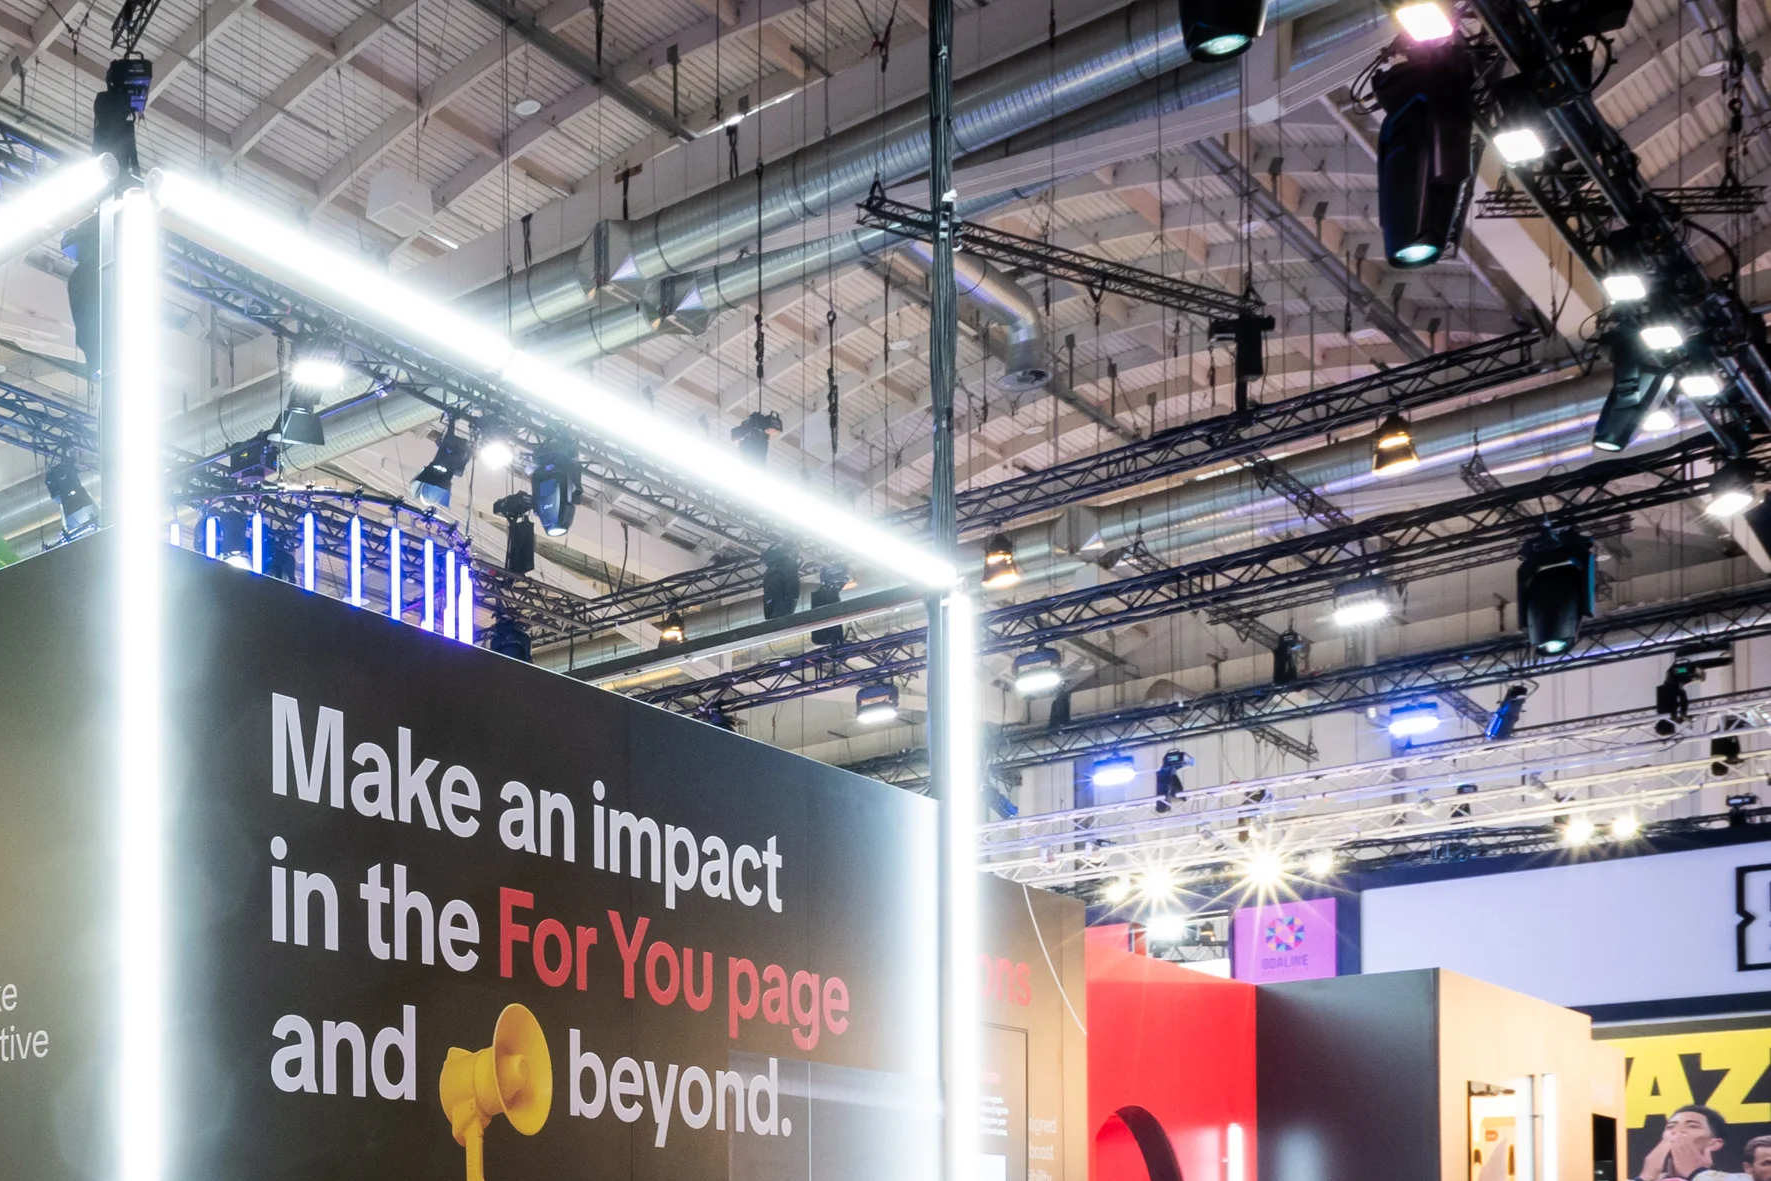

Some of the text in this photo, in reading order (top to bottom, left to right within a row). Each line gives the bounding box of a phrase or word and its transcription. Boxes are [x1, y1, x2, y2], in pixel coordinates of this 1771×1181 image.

[271, 692, 783, 914] Make an impact
[270, 835, 850, 1051] in the For You page
[270, 1004, 793, 1148] and beyond.
